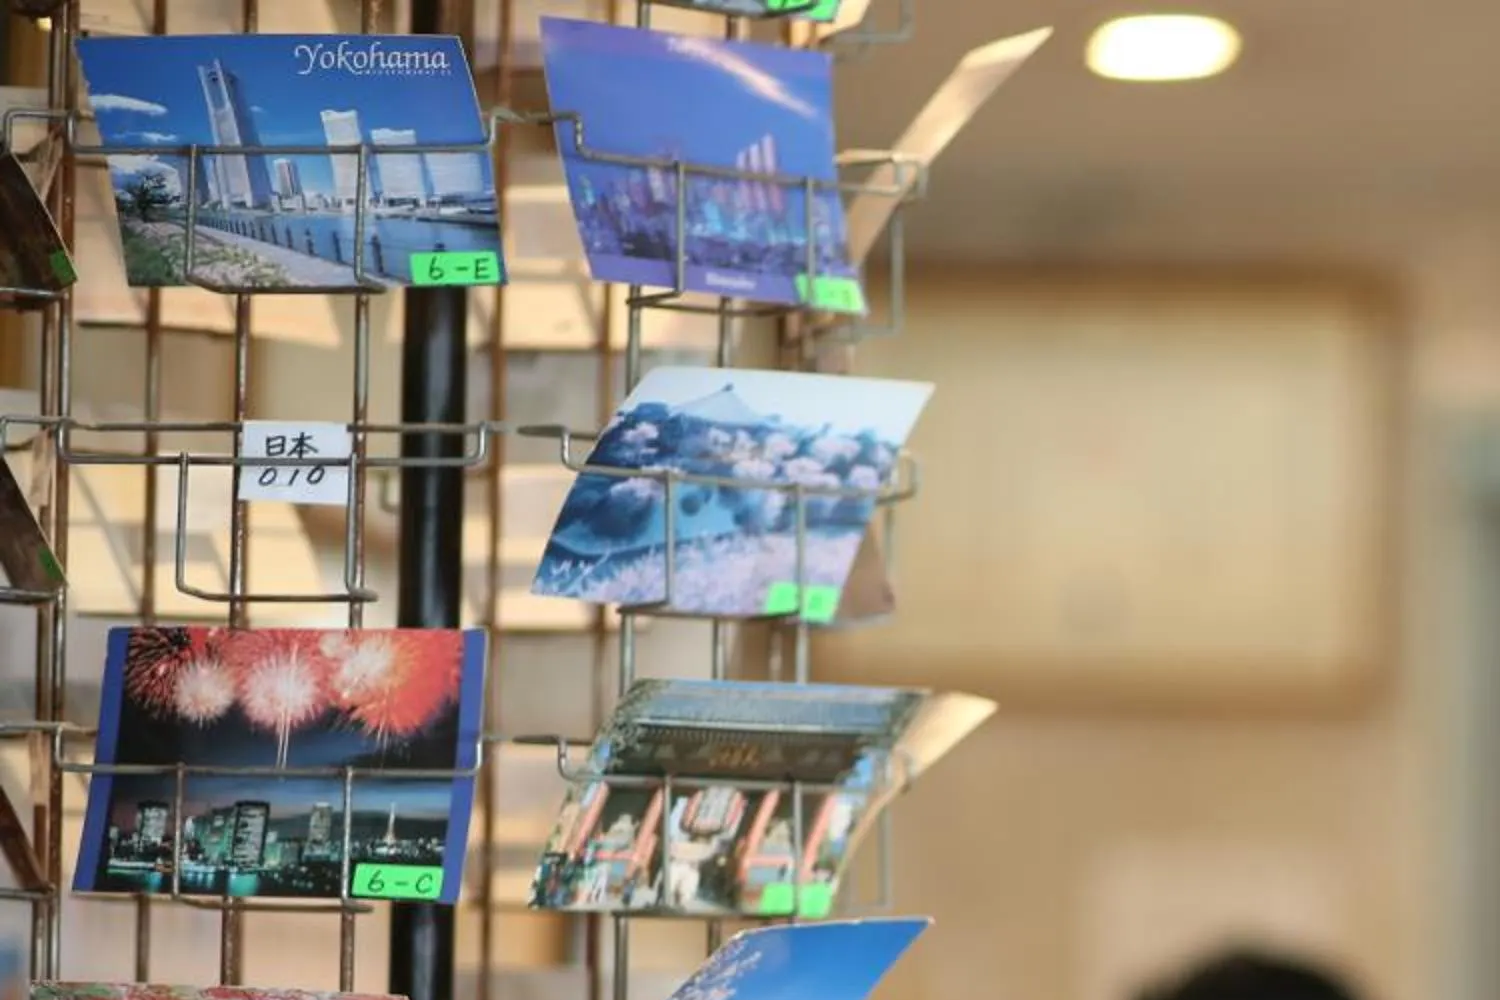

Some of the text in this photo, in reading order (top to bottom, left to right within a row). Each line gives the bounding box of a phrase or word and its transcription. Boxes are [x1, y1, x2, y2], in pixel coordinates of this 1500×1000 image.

[294, 41, 450, 75] Yokohama
[428, 255, 491, 281] 6-E
[265, 431, 319, 459] 日本
[258, 465, 326, 487] 010
[366, 869, 435, 894] 6-C
